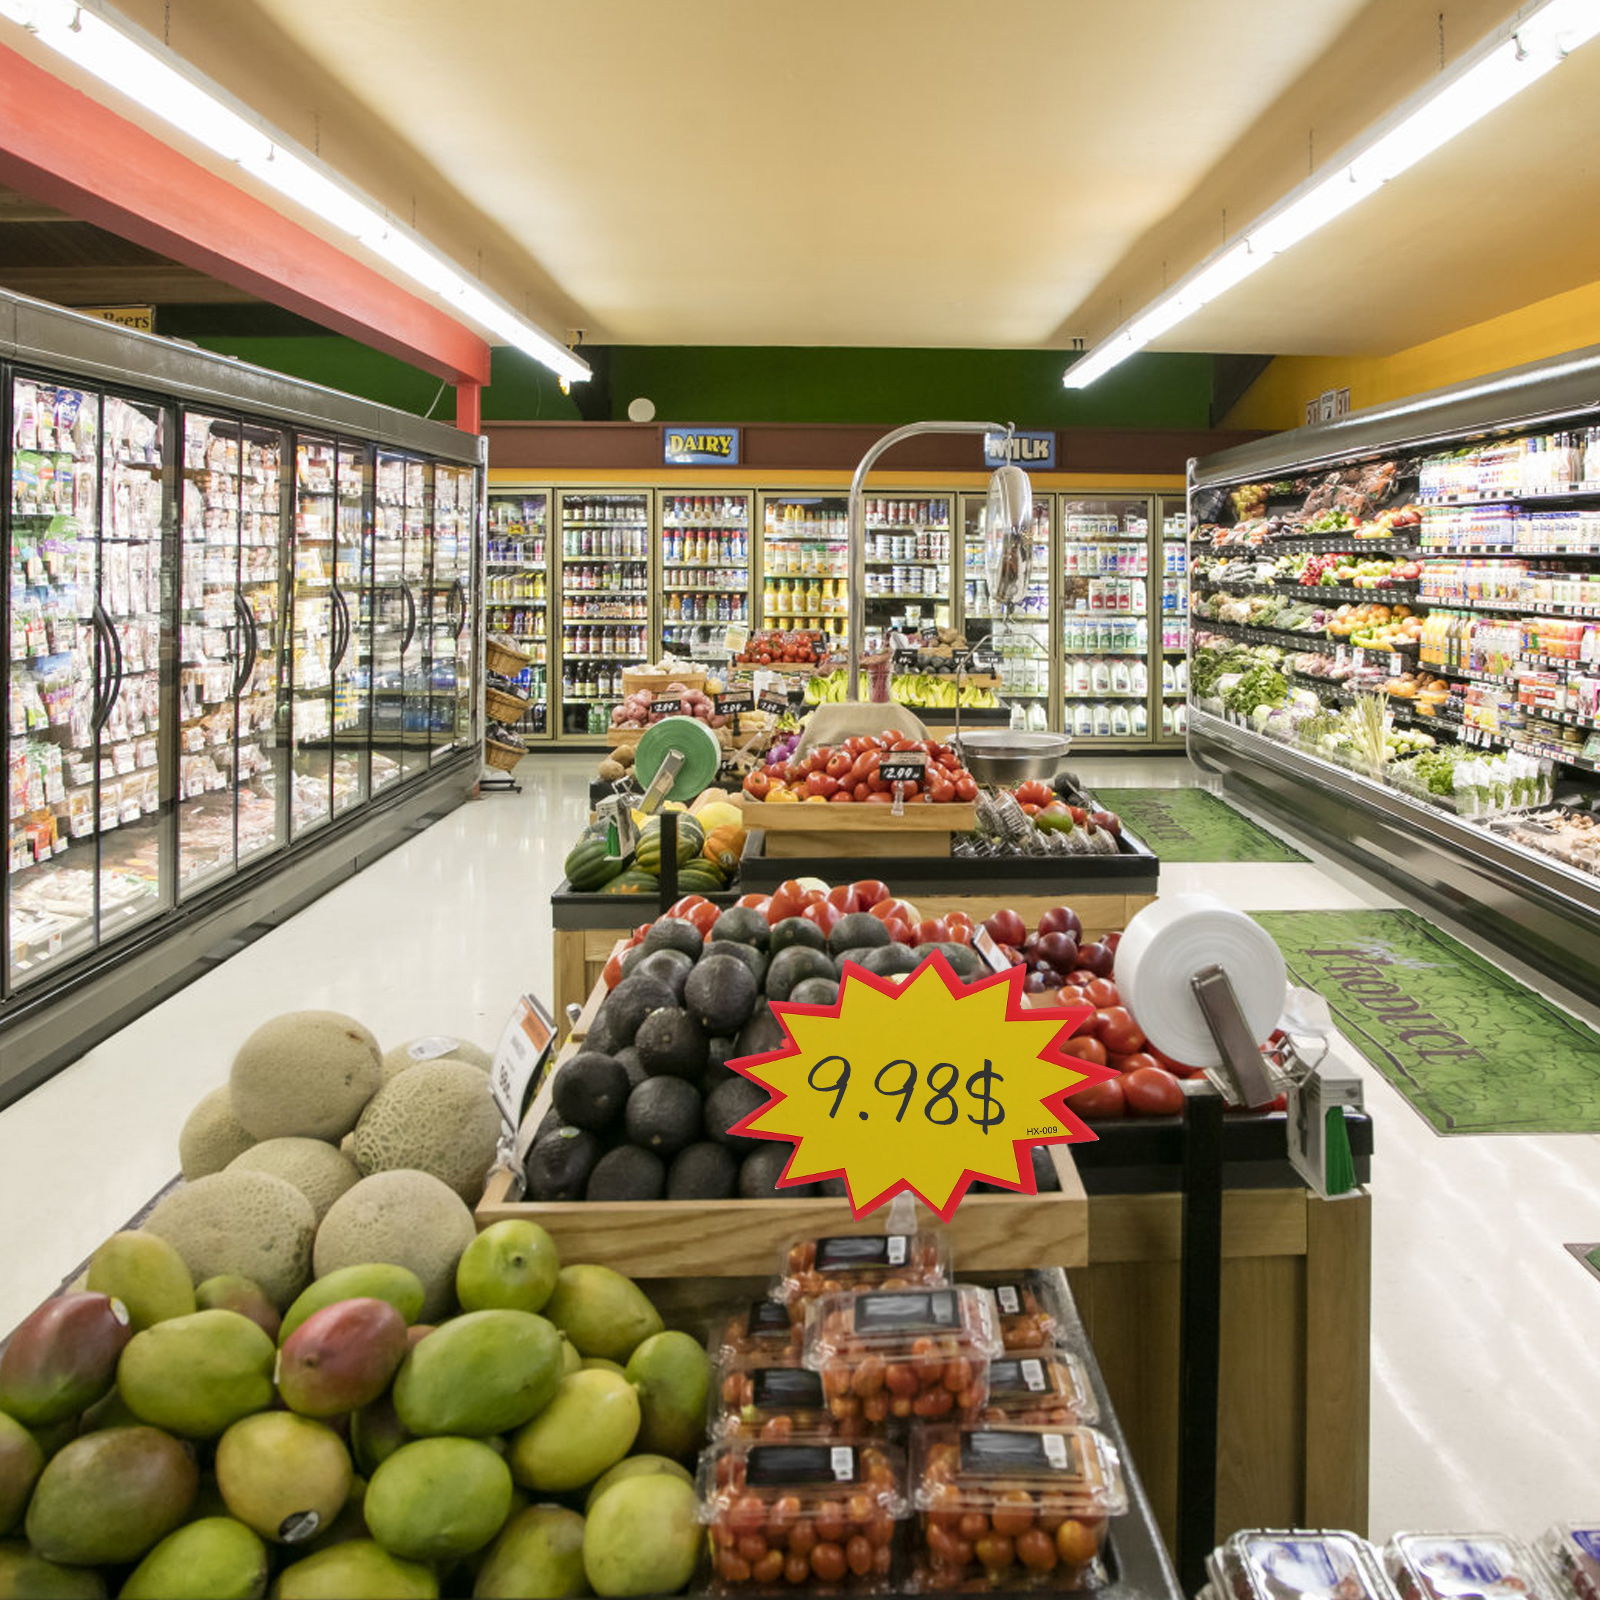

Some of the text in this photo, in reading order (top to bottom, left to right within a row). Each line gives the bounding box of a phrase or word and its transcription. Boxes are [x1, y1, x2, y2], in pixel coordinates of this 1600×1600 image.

[668, 434, 732, 456] DAIRY
[988, 437, 1050, 460] MILK
[1303, 948, 1491, 1065] PRODUCE
[807, 1055, 1005, 1135] 9.98$
[1026, 1126, 1058, 1136] HX-009
